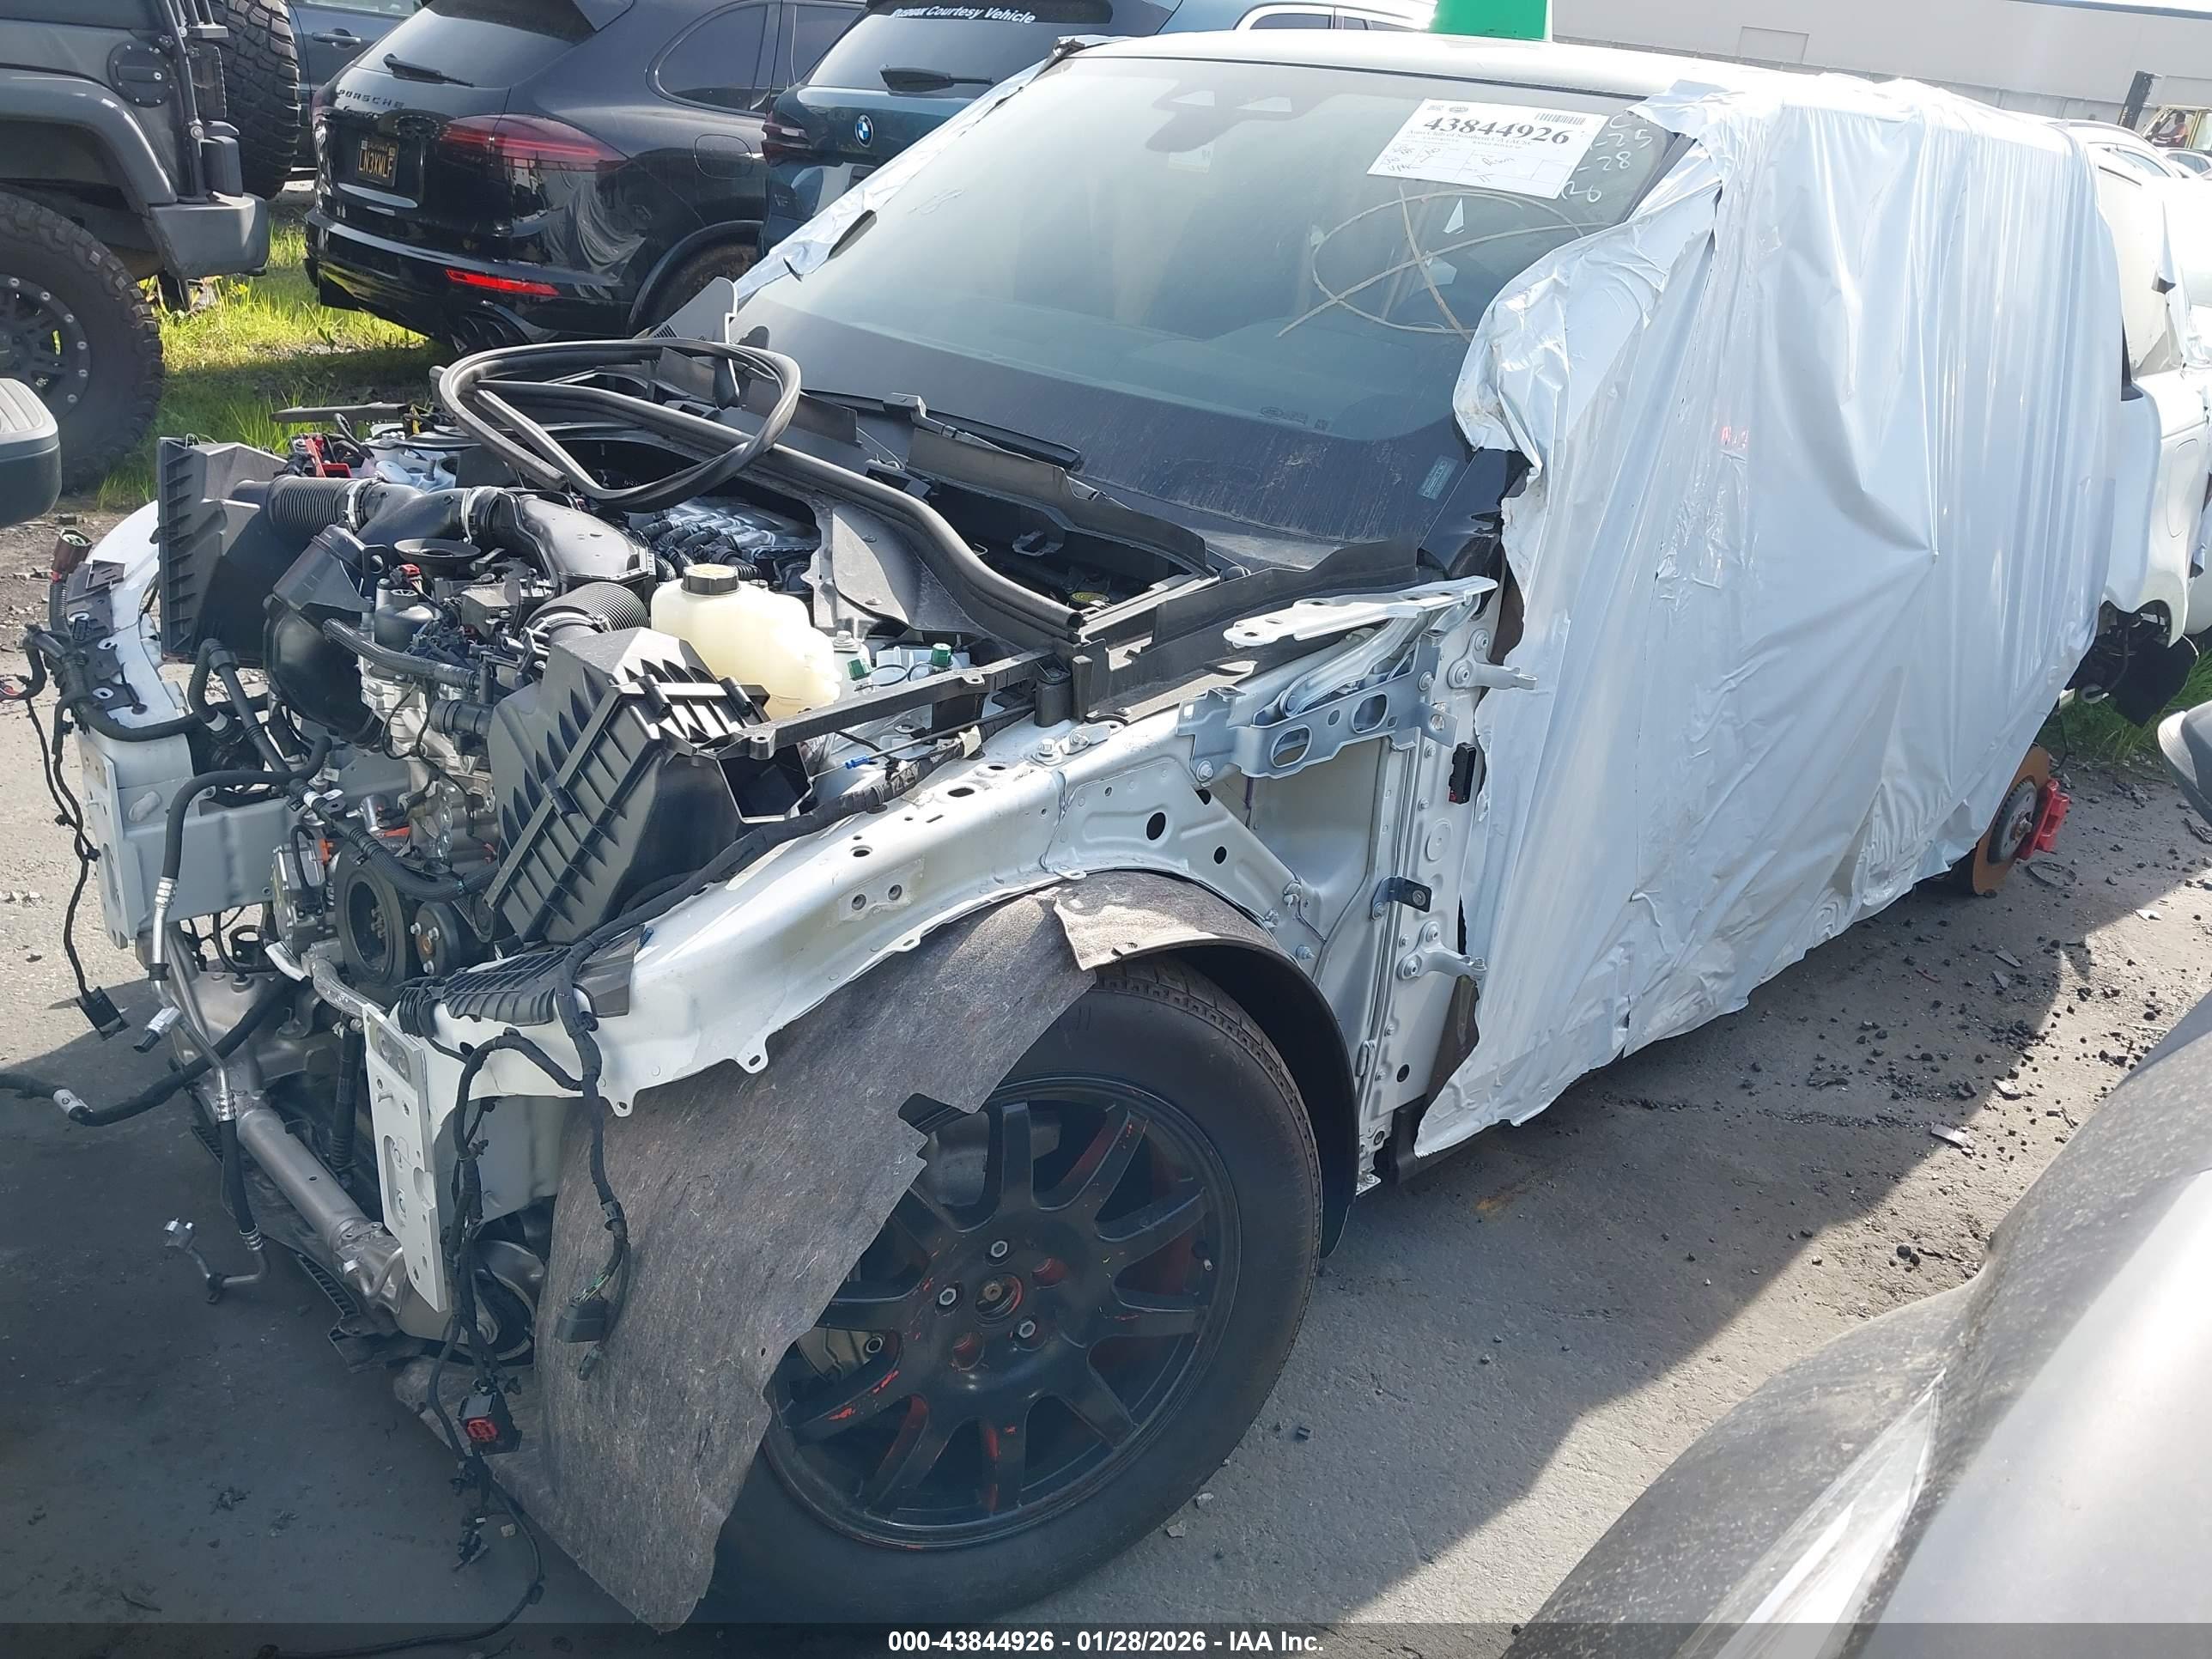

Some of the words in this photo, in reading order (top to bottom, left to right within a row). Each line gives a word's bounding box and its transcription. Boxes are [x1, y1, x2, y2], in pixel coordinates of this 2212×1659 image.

[927, 6, 985, 19] Courtesy
[984, 8, 1036, 23] Vehicle
[337, 88, 404, 108] PORSCHE
[1423, 117, 1574, 144] 43844926
[358, 149, 393, 179] LN3XWLF
